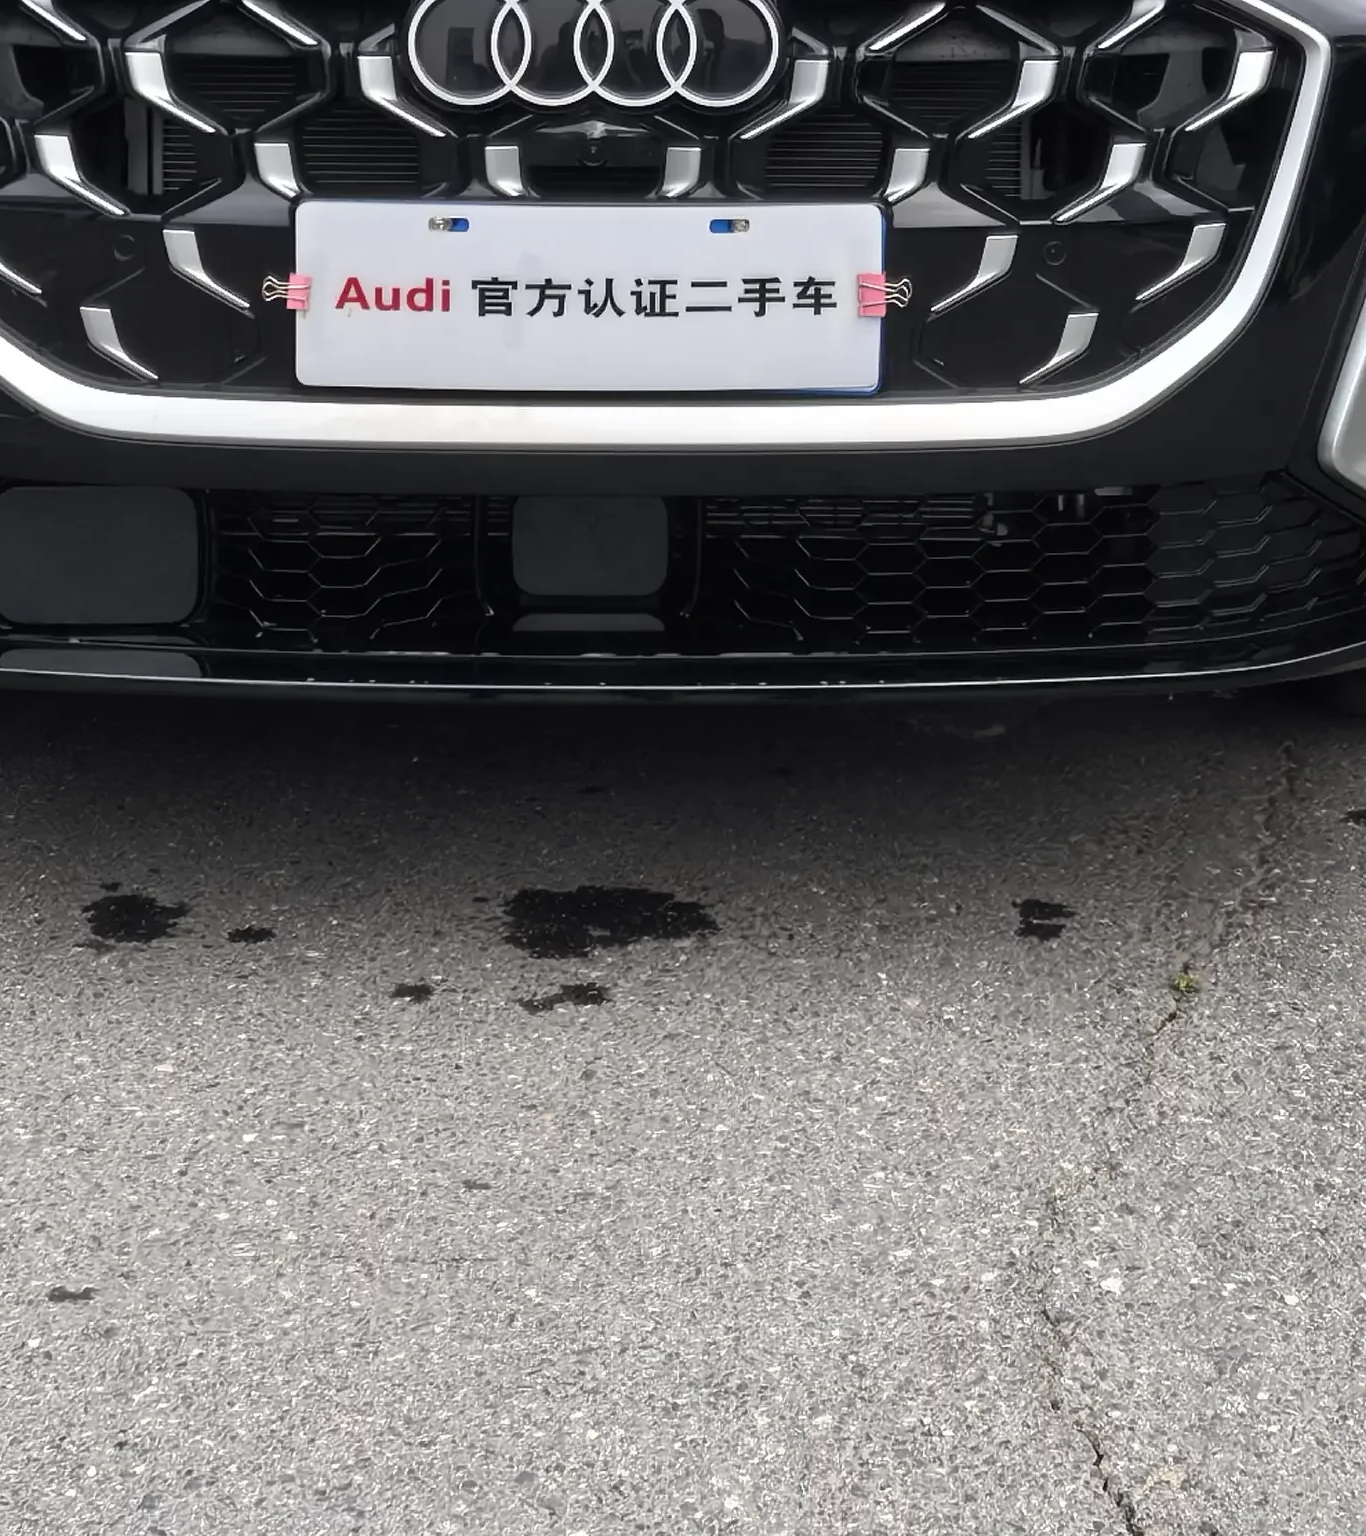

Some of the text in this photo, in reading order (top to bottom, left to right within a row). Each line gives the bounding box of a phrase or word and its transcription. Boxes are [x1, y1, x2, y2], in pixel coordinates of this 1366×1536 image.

[336, 275, 838, 319] Audi 官方认证二手车
